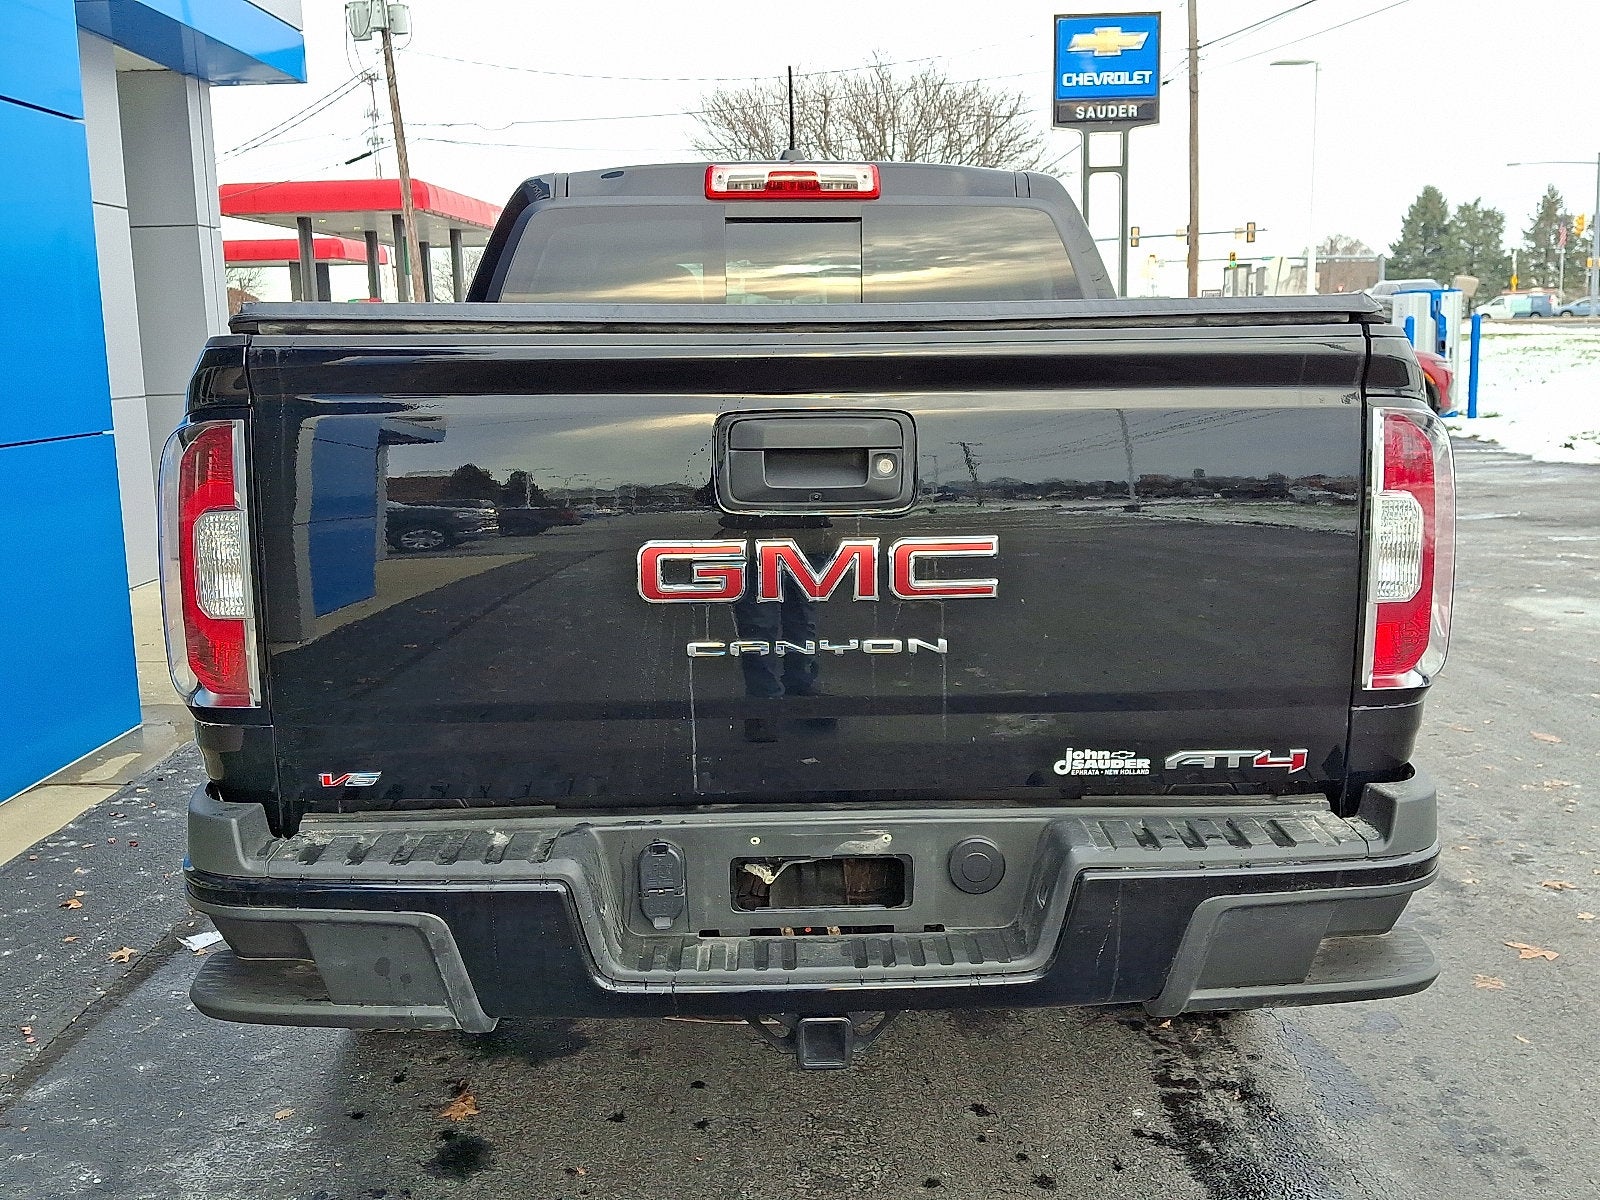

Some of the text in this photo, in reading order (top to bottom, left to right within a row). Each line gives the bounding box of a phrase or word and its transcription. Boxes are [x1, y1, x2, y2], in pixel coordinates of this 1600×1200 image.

[1062, 70, 1152, 87] CHEVROLET
[1075, 104, 1138, 119] SAUDER
[637, 535, 999, 603] GMC
[687, 638, 948, 657] CANYON
[1072, 759, 1151, 769] SAUDER
[1164, 748, 1309, 774] AT4
[318, 771, 382, 787] V6
